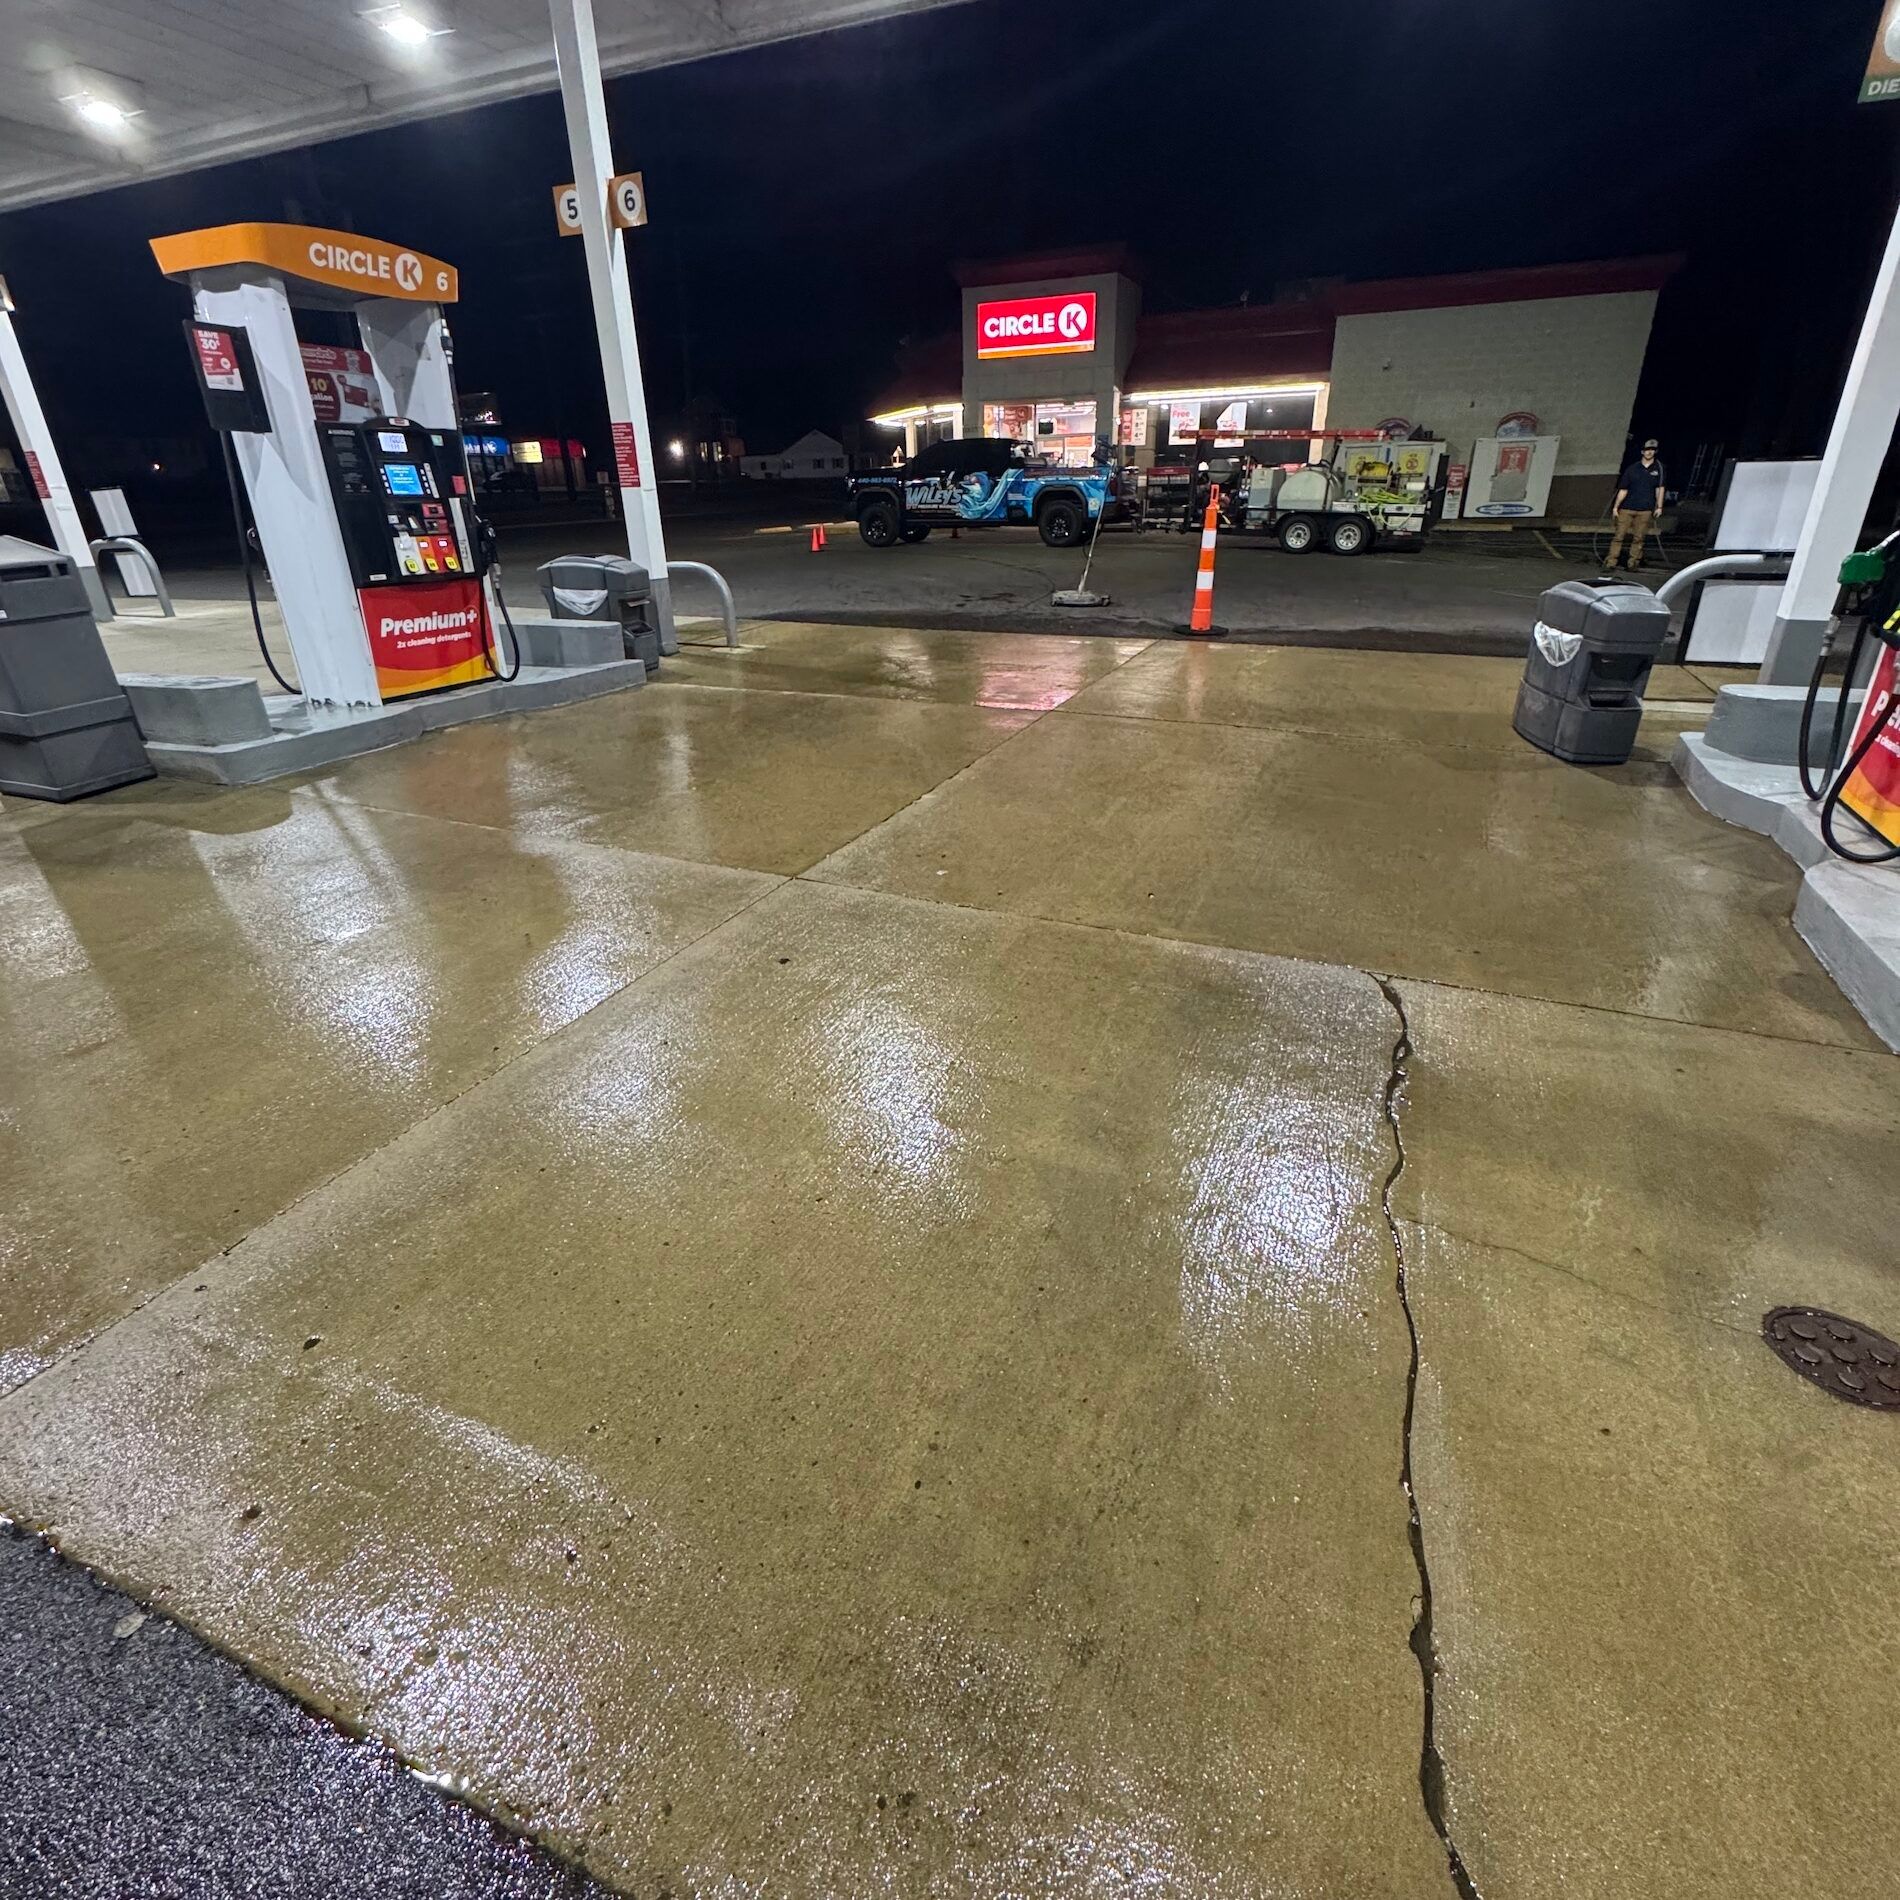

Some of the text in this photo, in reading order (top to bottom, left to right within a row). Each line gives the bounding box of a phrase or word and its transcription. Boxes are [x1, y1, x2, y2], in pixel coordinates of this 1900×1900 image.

[566, 198, 578, 219] 5
[624, 189, 635, 211] 6
[309, 242, 422, 290] CIRCLE K
[437, 271, 448, 291] 6
[984, 307, 1085, 338] CIRCLE K
[197, 330, 219, 339] SAVE
[311, 392, 334, 402] allon
[381, 609, 478, 637] Premium+
[407, 637, 436, 647] cleaning
[436, 631, 472, 643] detergents
